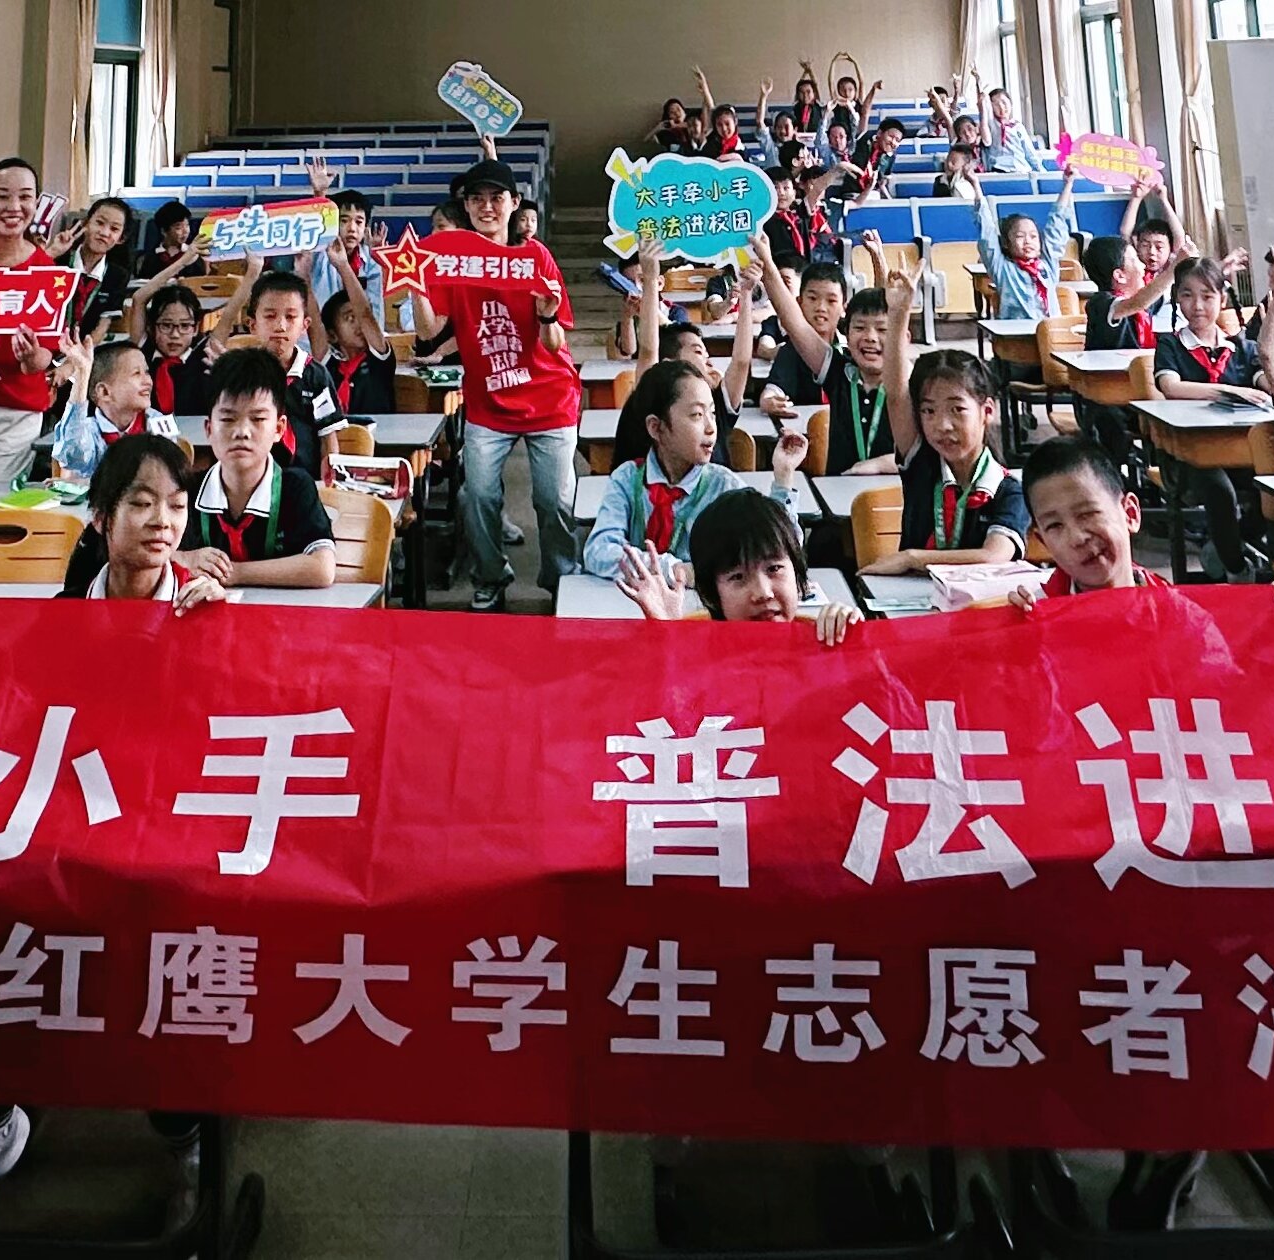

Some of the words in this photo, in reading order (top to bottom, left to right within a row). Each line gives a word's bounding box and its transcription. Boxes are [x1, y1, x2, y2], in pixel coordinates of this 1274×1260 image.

[635, 177, 751, 209] 大手牵小手
[212, 207, 322, 249] 与法同行
[635, 209, 752, 241] 普法进校园
[434, 255, 535, 280] 党建引领
